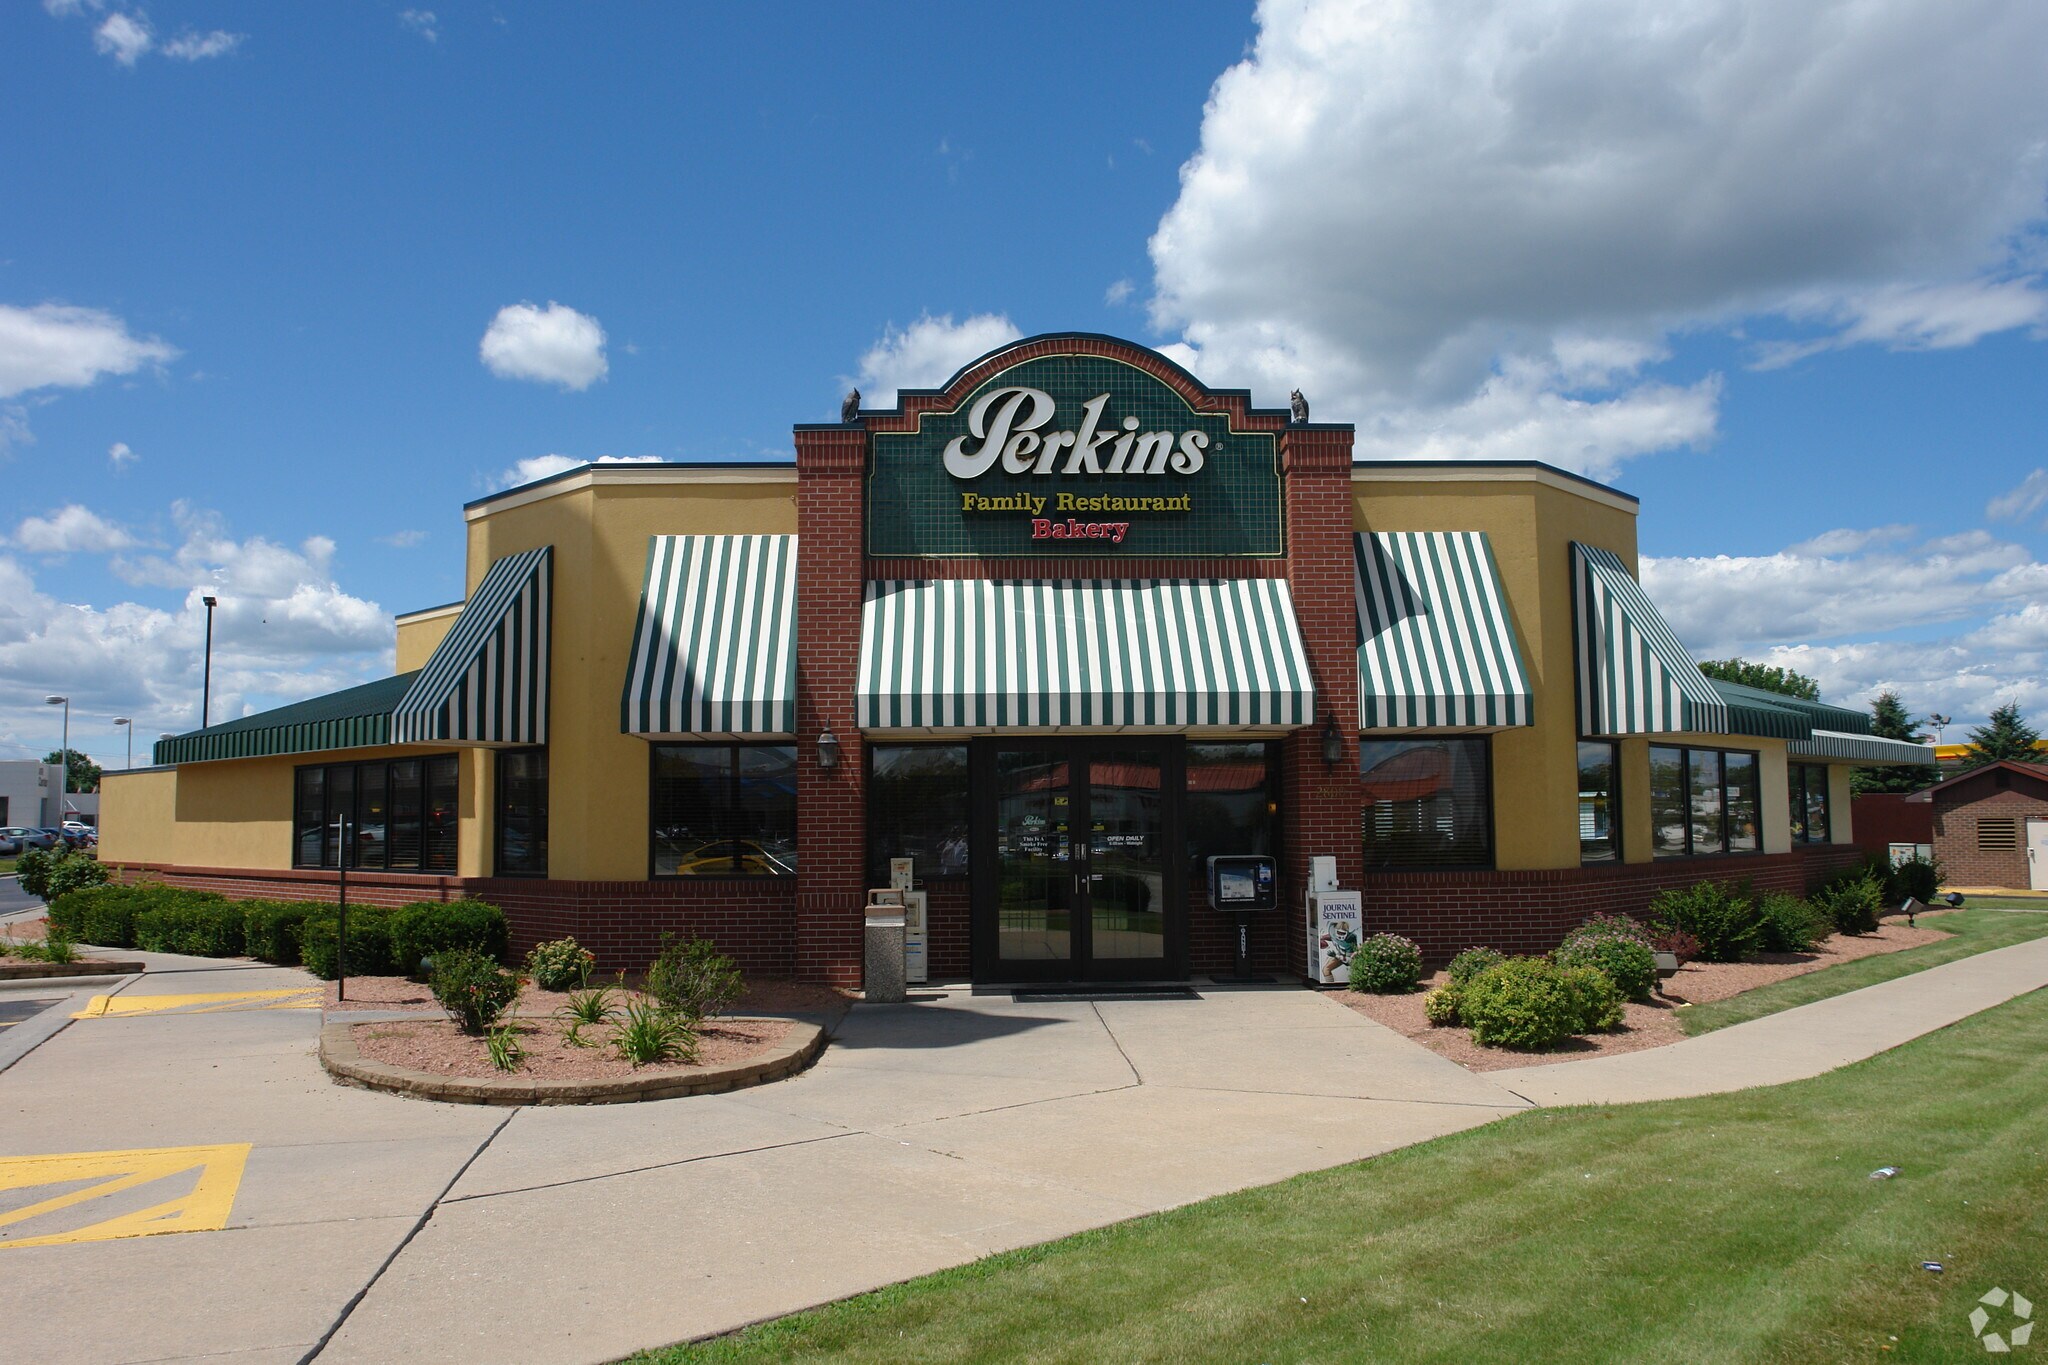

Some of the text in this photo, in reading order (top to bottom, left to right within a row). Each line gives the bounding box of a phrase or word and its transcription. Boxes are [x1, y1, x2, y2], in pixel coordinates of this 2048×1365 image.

[943, 386, 1209, 479] Perkins
[961, 493, 1191, 515] Family Restaurant
[1032, 519, 1129, 543] Bakery
[1322, 912, 1357, 920] SENTINEL
[1323, 904, 1357, 913] JOURNAL
